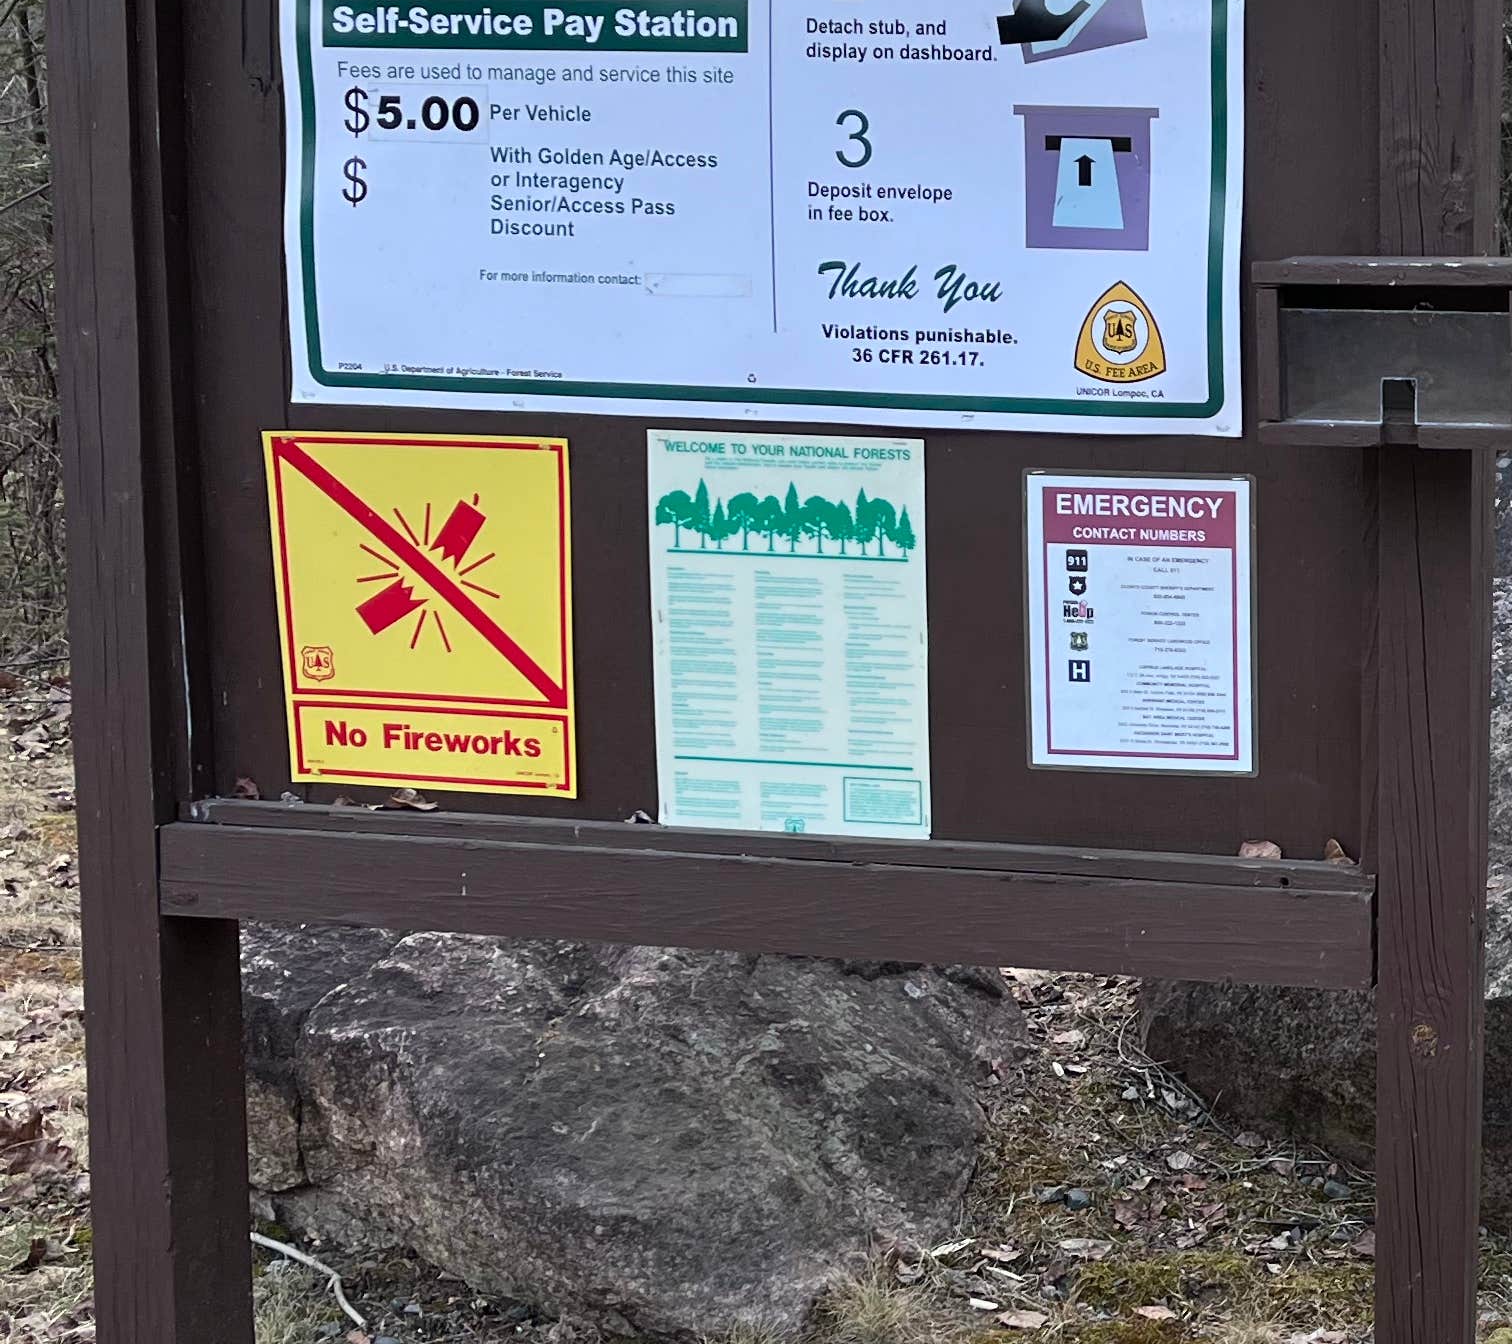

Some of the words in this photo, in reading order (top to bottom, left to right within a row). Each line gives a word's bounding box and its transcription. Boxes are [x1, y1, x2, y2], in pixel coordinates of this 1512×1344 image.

[332, 6, 533, 36] Self-Service
[543, 8, 604, 42] Pay
[614, 9, 738, 38] Station
[806, 19, 863, 35] Detach
[868, 20, 910, 38] stub,
[916, 20, 946, 35] and
[806, 44, 867, 64] display
[872, 48, 894, 61] on
[900, 45, 998, 62] dashboard.
[337, 61, 382, 80] Fees
[387, 66, 416, 80] are
[421, 63, 462, 81] used
[466, 65, 483, 81] to
[488, 67, 556, 86] manage
[561, 65, 595, 83] and
[599, 66, 661, 83] service
[666, 66, 698, 84] this
[702, 67, 735, 84] site
[489, 104, 521, 122] Per
[525, 105, 592, 123] Vehicle
[835, 109, 873, 168] 3
[342, 156, 368, 207] $
[490, 147, 532, 165] With
[537, 147, 604, 166] Golden
[608, 149, 719, 170] Age/Access
[490, 173, 509, 189] or
[515, 172, 624, 194] Interagency
[807, 181, 873, 201] Deposit
[877, 184, 953, 203] envelope
[490, 195, 625, 215] Senior/Access
[631, 197, 676, 216] Pass
[808, 205, 823, 221] in
[828, 206, 853, 222] fee
[858, 207, 894, 223] box.
[490, 219, 575, 238] Discount
[480, 270, 498, 283] For
[500, 272, 529, 284] more
[531, 271, 596, 284] information
[818, 260, 919, 302] Thank
[934, 264, 1003, 313] You
[821, 324, 910, 342] Violations
[915, 326, 1019, 347] punishable.
[852, 348, 874, 364] 36
[878, 349, 913, 365] CFR
[919, 350, 985, 366] 261.17.
[401, 365, 445, 374] Department
[456, 367, 500, 377] Agriculture
[506, 368, 532, 377] Forest
[1105, 366, 1125, 378] FEE
[1127, 361, 1158, 377] AREA
[1151, 389, 1165, 398] CA
[664, 440, 726, 454] WELCOME
[730, 443, 747, 455] TO
[752, 444, 785, 456] YOUR
[790, 446, 848, 459] NATIONAL
[854, 447, 911, 461] FORESTS
[1056, 493, 1224, 519] EMERGENCY
[1072, 527, 1136, 540] CONTACT
[1139, 529, 1206, 543] NUMBERS
[1067, 555, 1087, 566] 911
[325, 720, 367, 748] No
[383, 723, 542, 758] Fireworks
